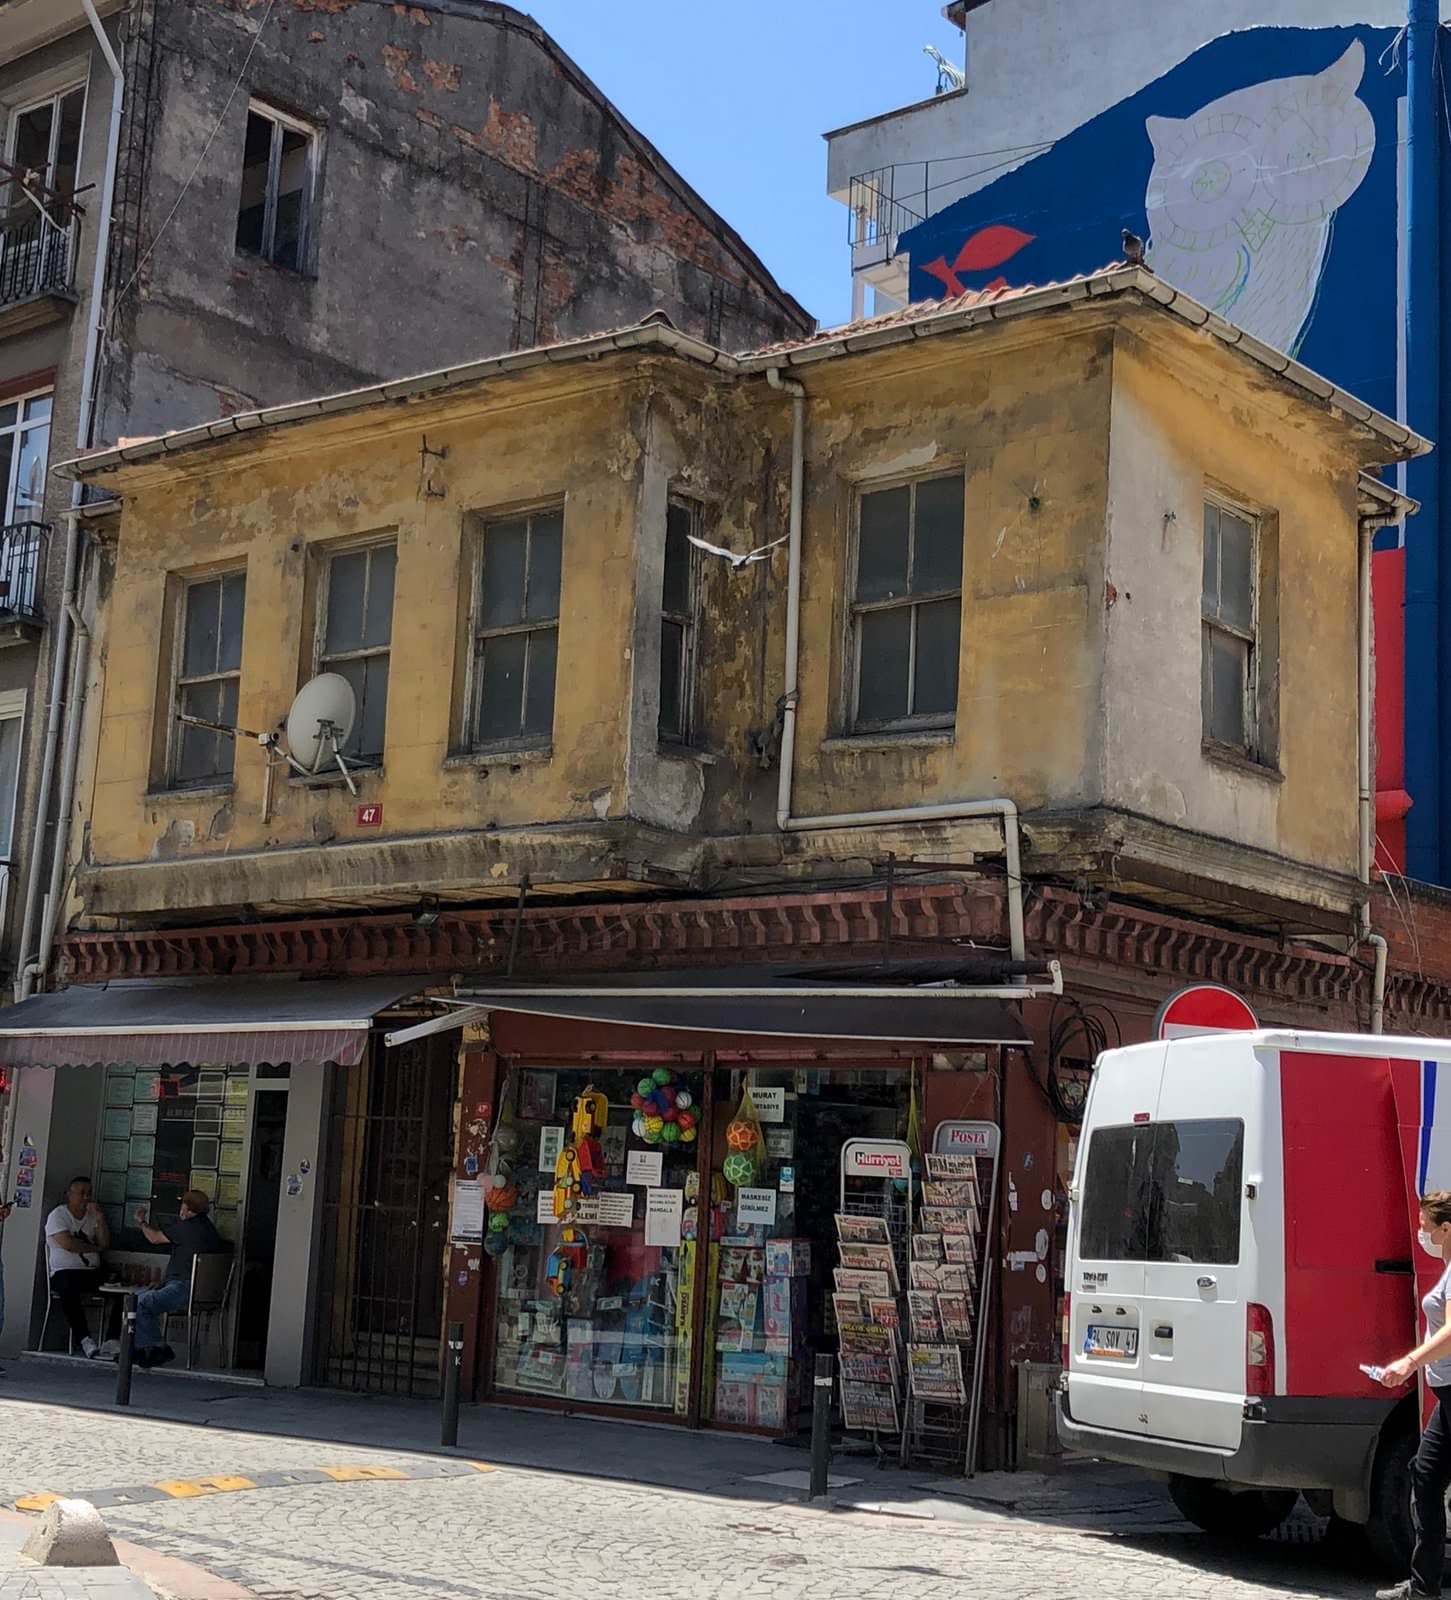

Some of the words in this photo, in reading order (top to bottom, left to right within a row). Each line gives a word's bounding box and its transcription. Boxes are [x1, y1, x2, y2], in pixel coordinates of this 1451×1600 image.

[362, 808, 376, 822] 47
[752, 1091, 777, 1099] MURAT
[855, 1151, 902, 1166] Hürriyet
